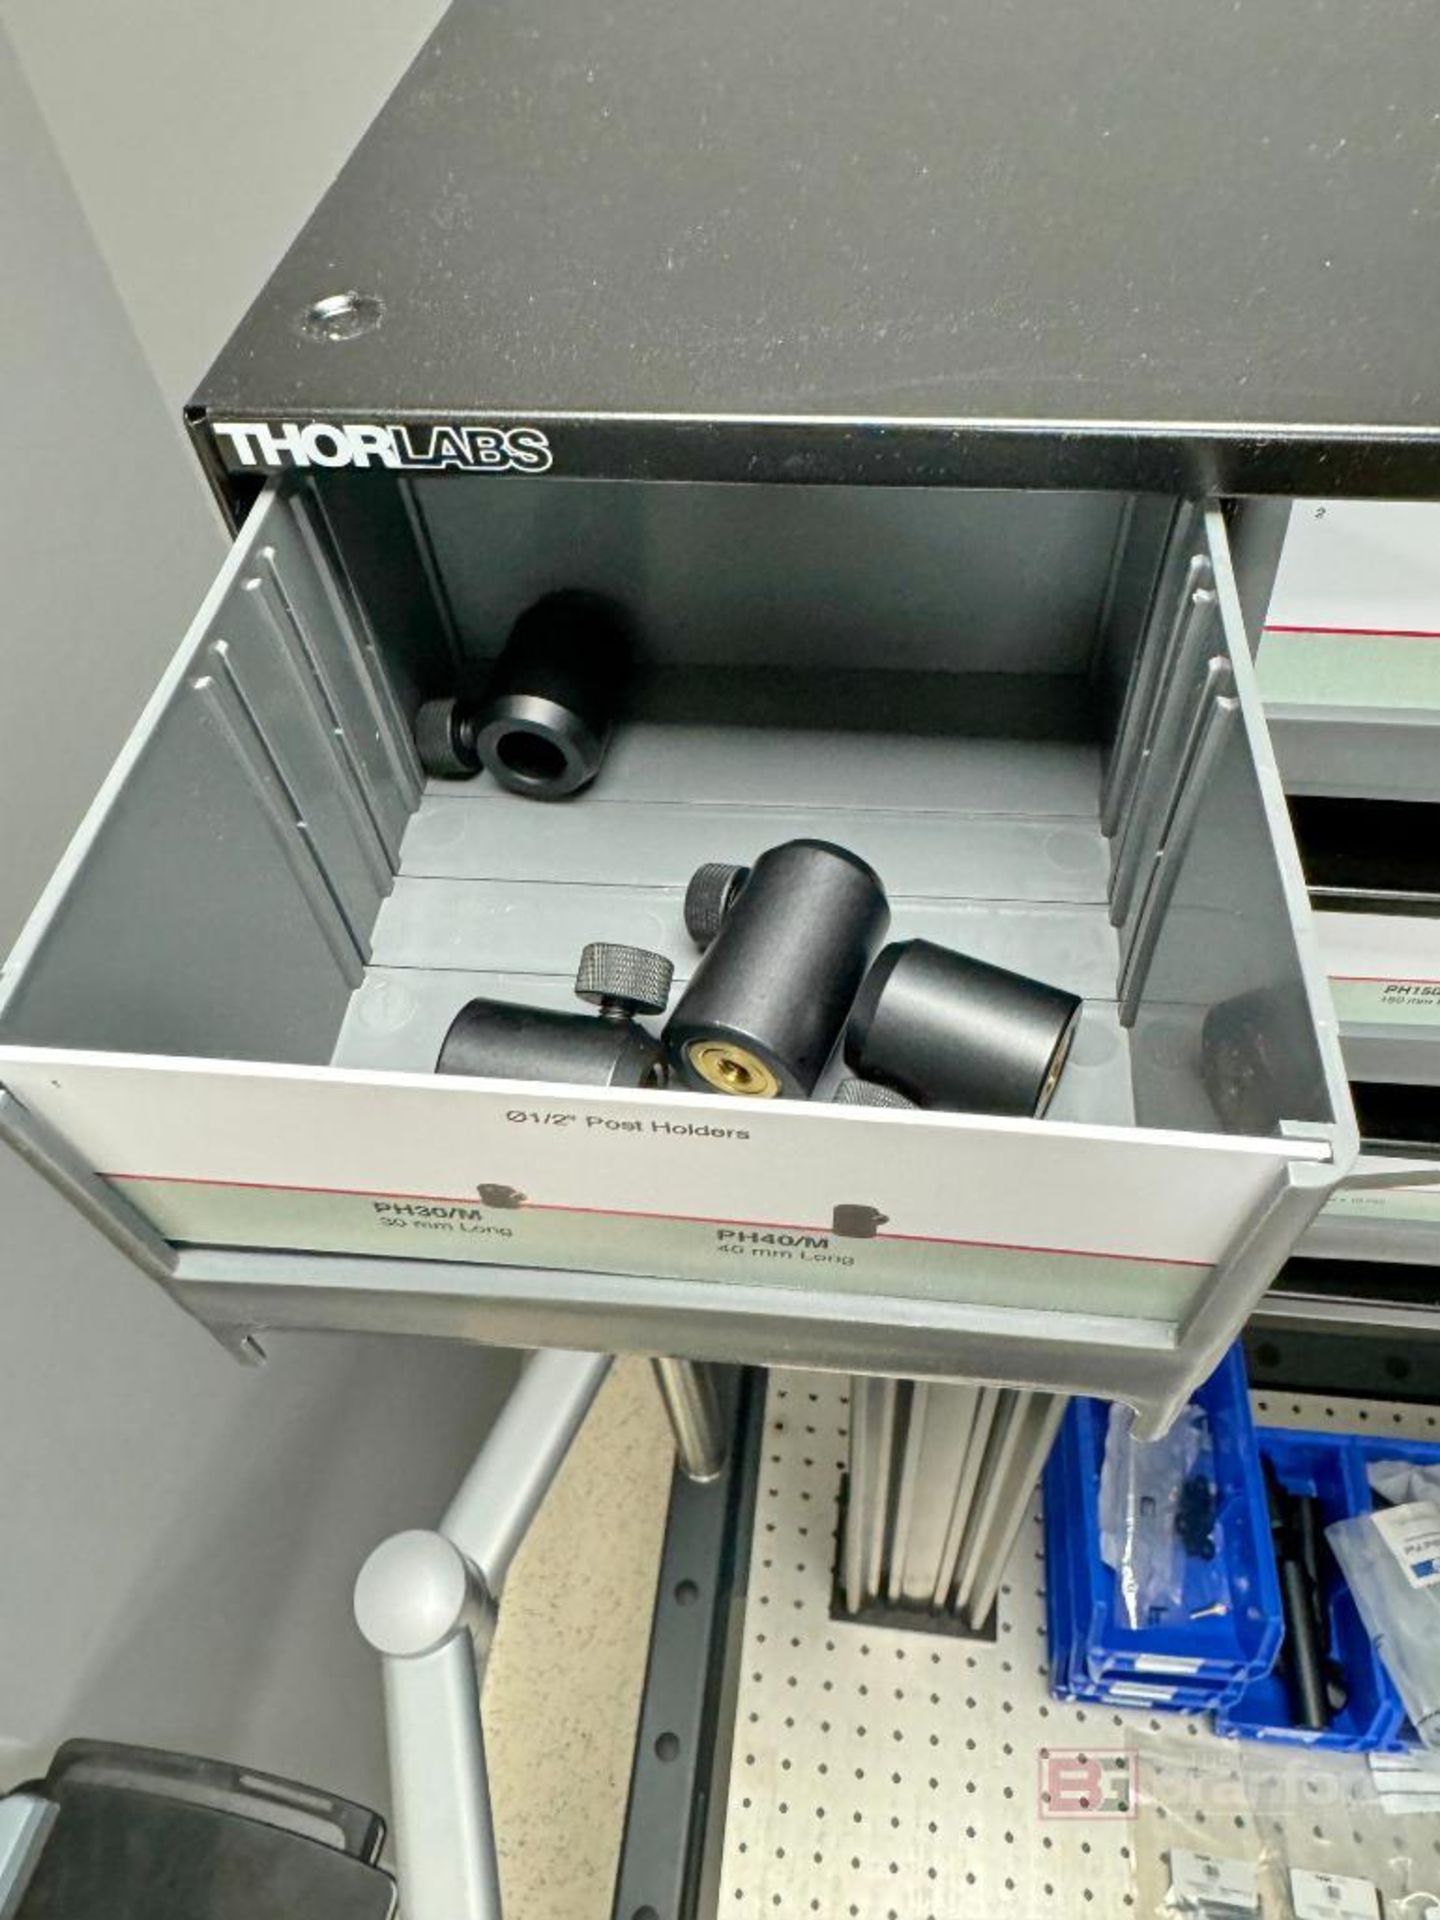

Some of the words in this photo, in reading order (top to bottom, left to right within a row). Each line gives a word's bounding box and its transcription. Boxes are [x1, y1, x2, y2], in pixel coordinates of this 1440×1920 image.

[212, 422, 553, 472] THORLABS
[586, 1115, 643, 1132] Post
[651, 1120, 751, 1140] Holders
[373, 1201, 482, 1221] PH30/M
[379, 1216, 407, 1228] 30
[413, 1219, 453, 1231] mm
[460, 1222, 513, 1238] Long
[716, 1229, 830, 1250] PH40/M
[717, 1243, 745, 1255] 40
[751, 1247, 793, 1260] mm
[800, 1251, 856, 1267] Long
